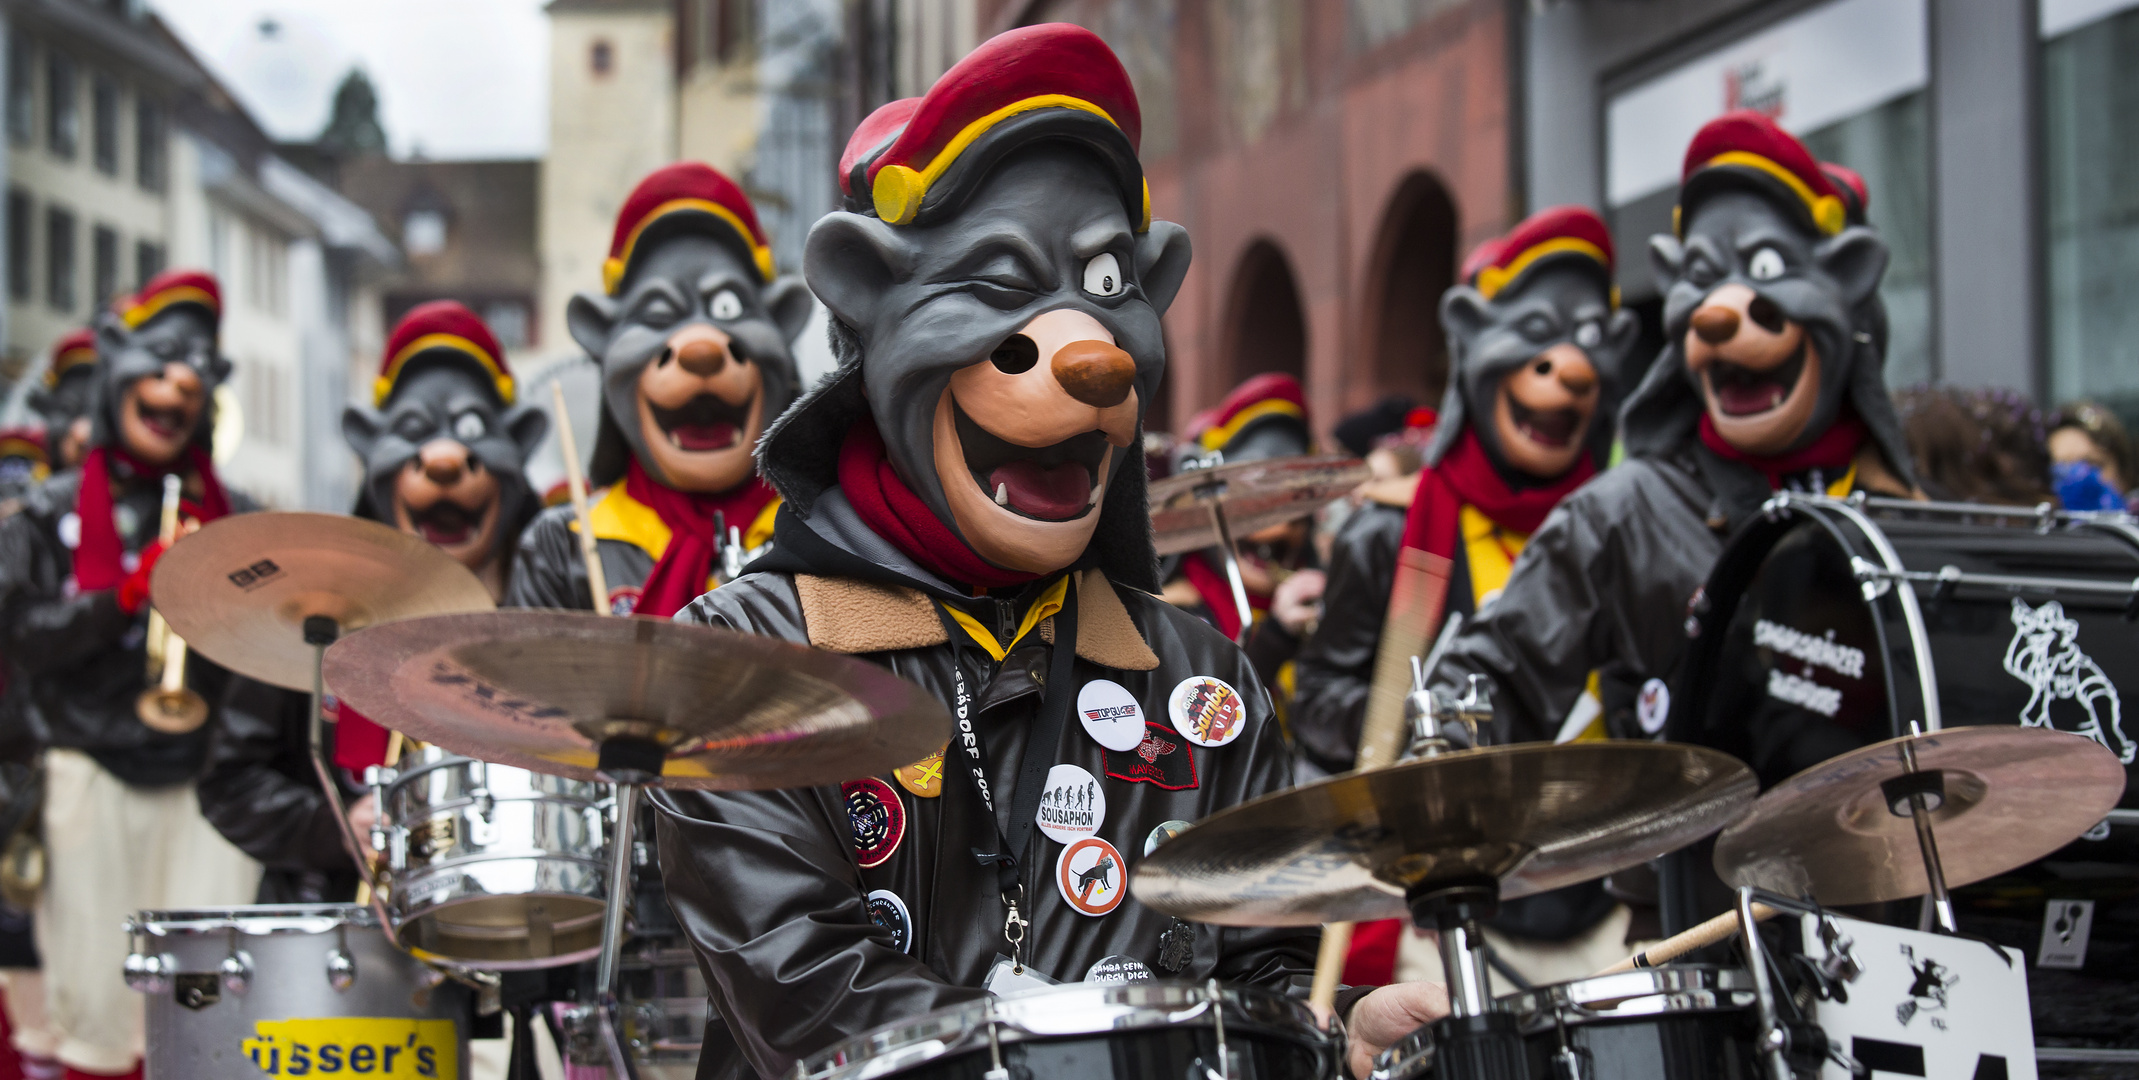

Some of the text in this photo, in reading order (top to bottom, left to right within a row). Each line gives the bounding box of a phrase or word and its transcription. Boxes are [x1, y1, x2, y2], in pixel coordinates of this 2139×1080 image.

[1097, 707, 1110, 718] TOP
[1188, 683, 1231, 743] Samba
[1215, 704, 1232, 729] VIP
[1128, 764, 1166, 782] MAVERICK
[1041, 806, 1094, 826] SOUSAPHON
[1092, 962, 1144, 974] SAMBA SEIN
[1094, 972, 1125, 983] DURCH
[1127, 970, 1149, 980] DICK
